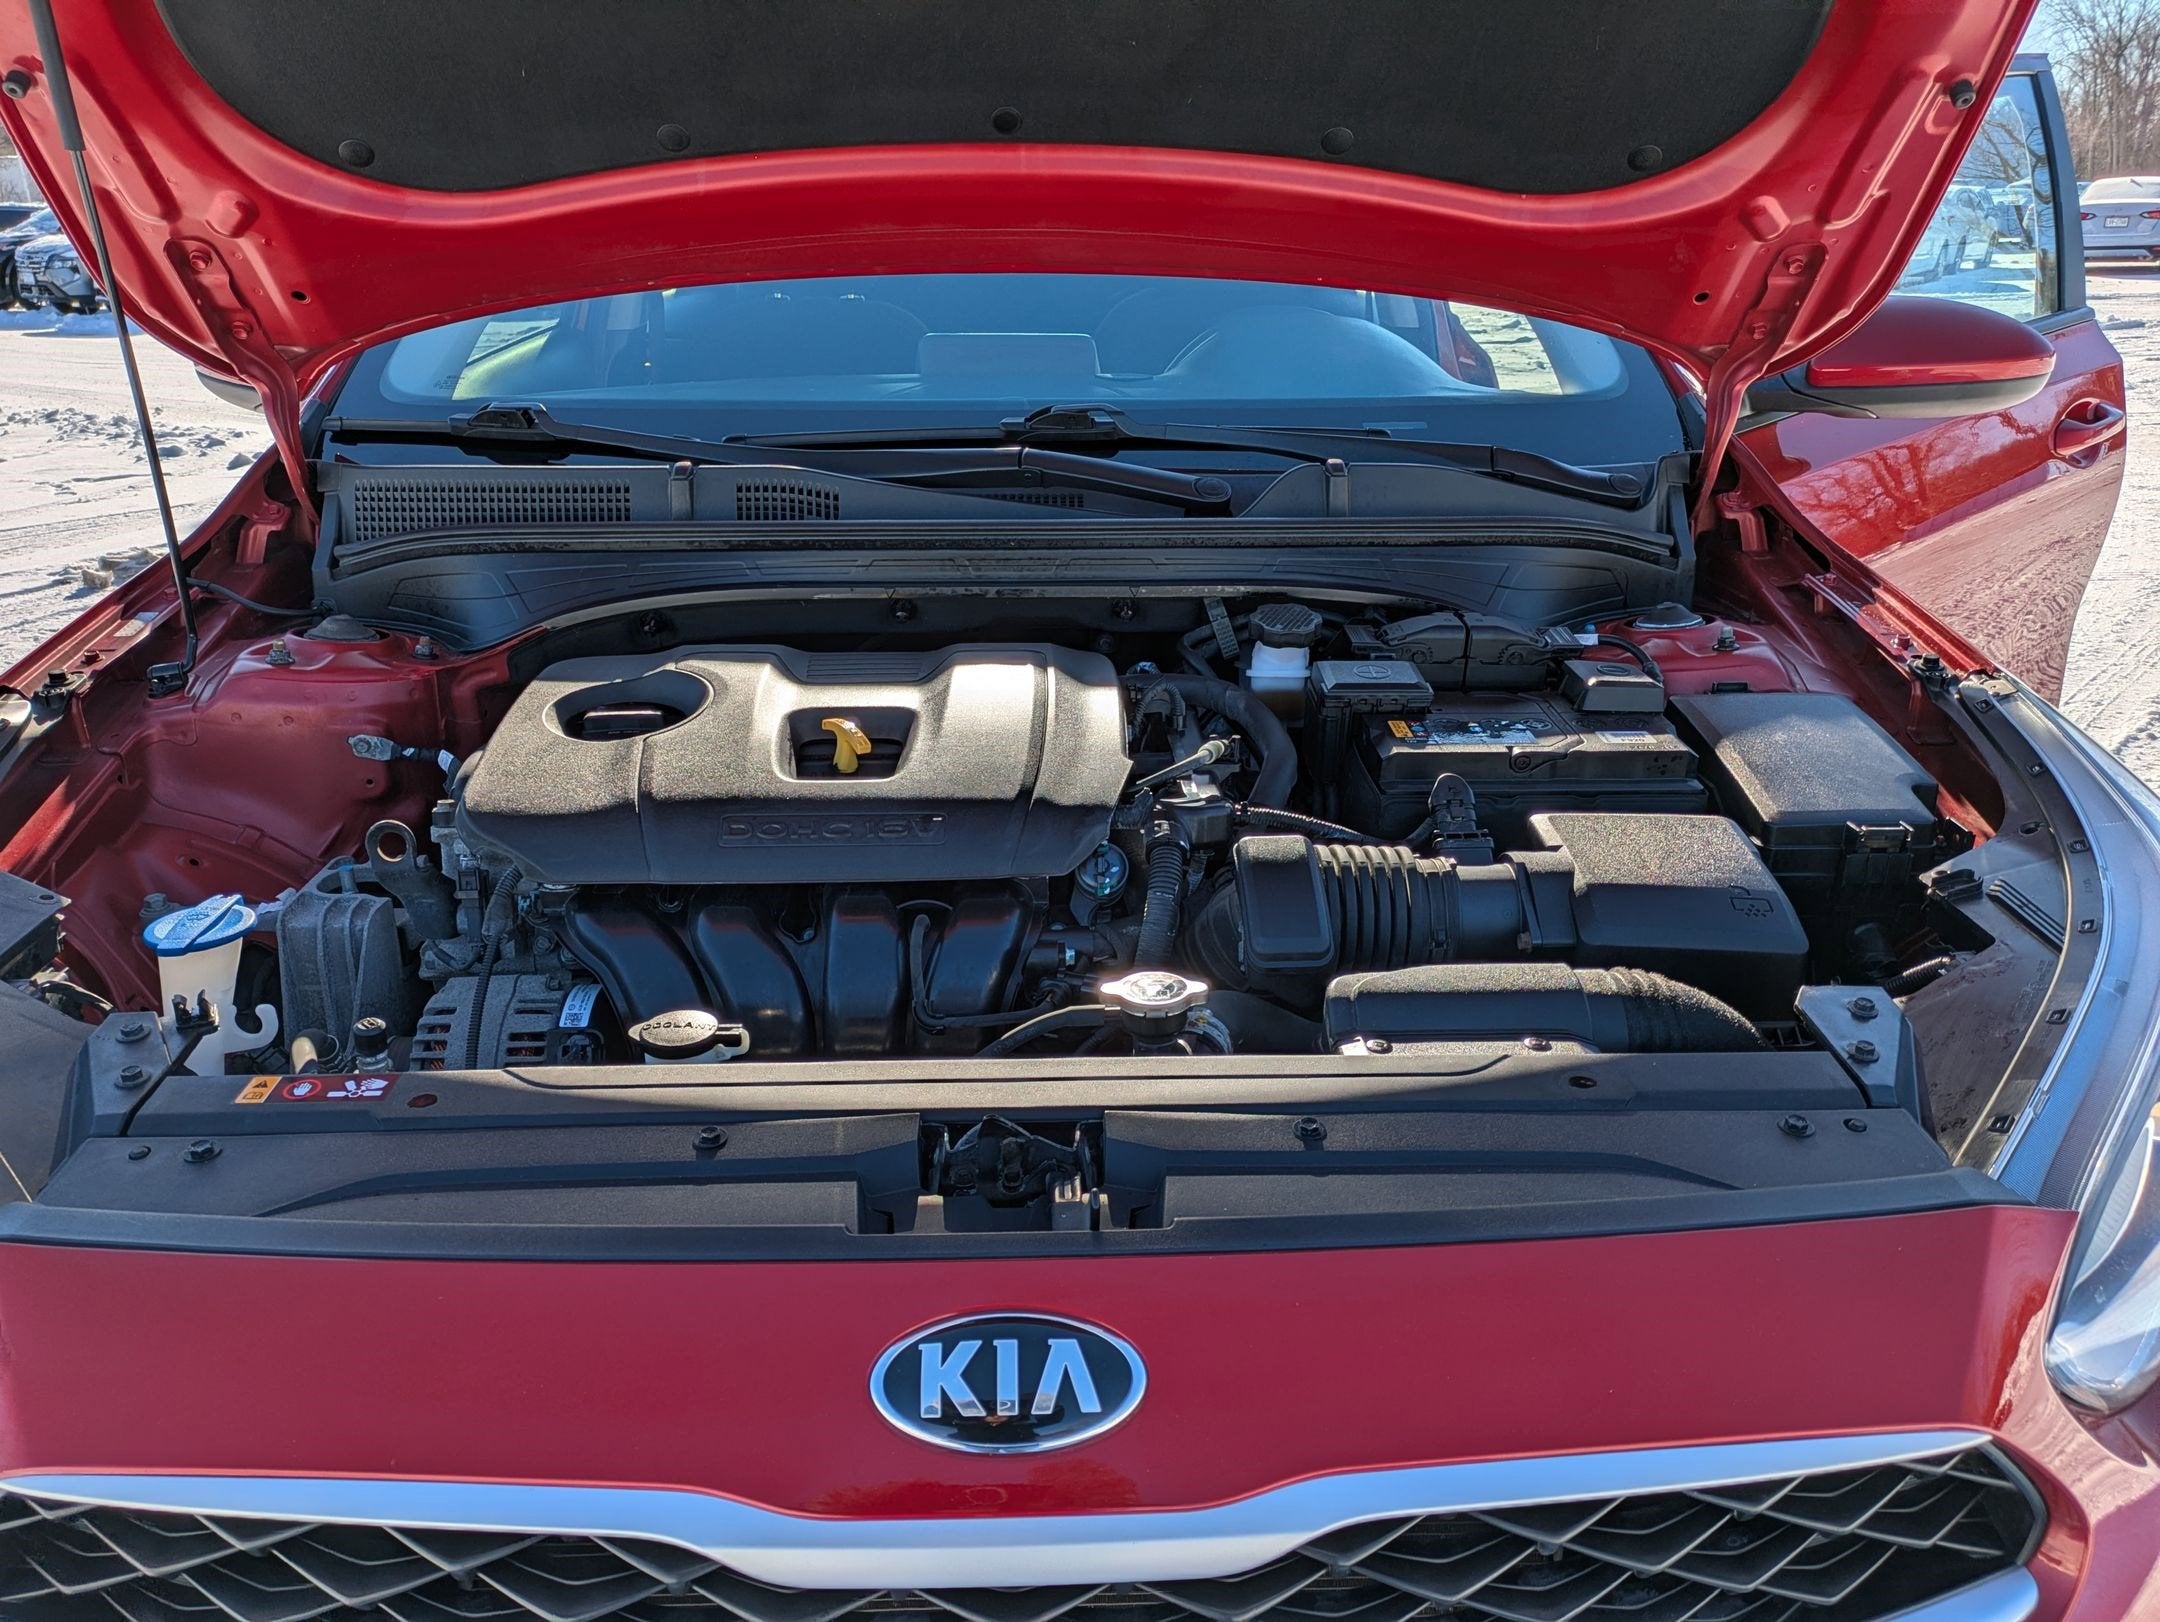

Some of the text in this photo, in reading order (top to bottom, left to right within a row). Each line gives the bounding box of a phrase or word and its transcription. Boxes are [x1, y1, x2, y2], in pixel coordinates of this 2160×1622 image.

[721, 815, 944, 840] DOHC 16V
[641, 1021, 716, 1031] COOLANT
[918, 1339, 1102, 1418] KIA
